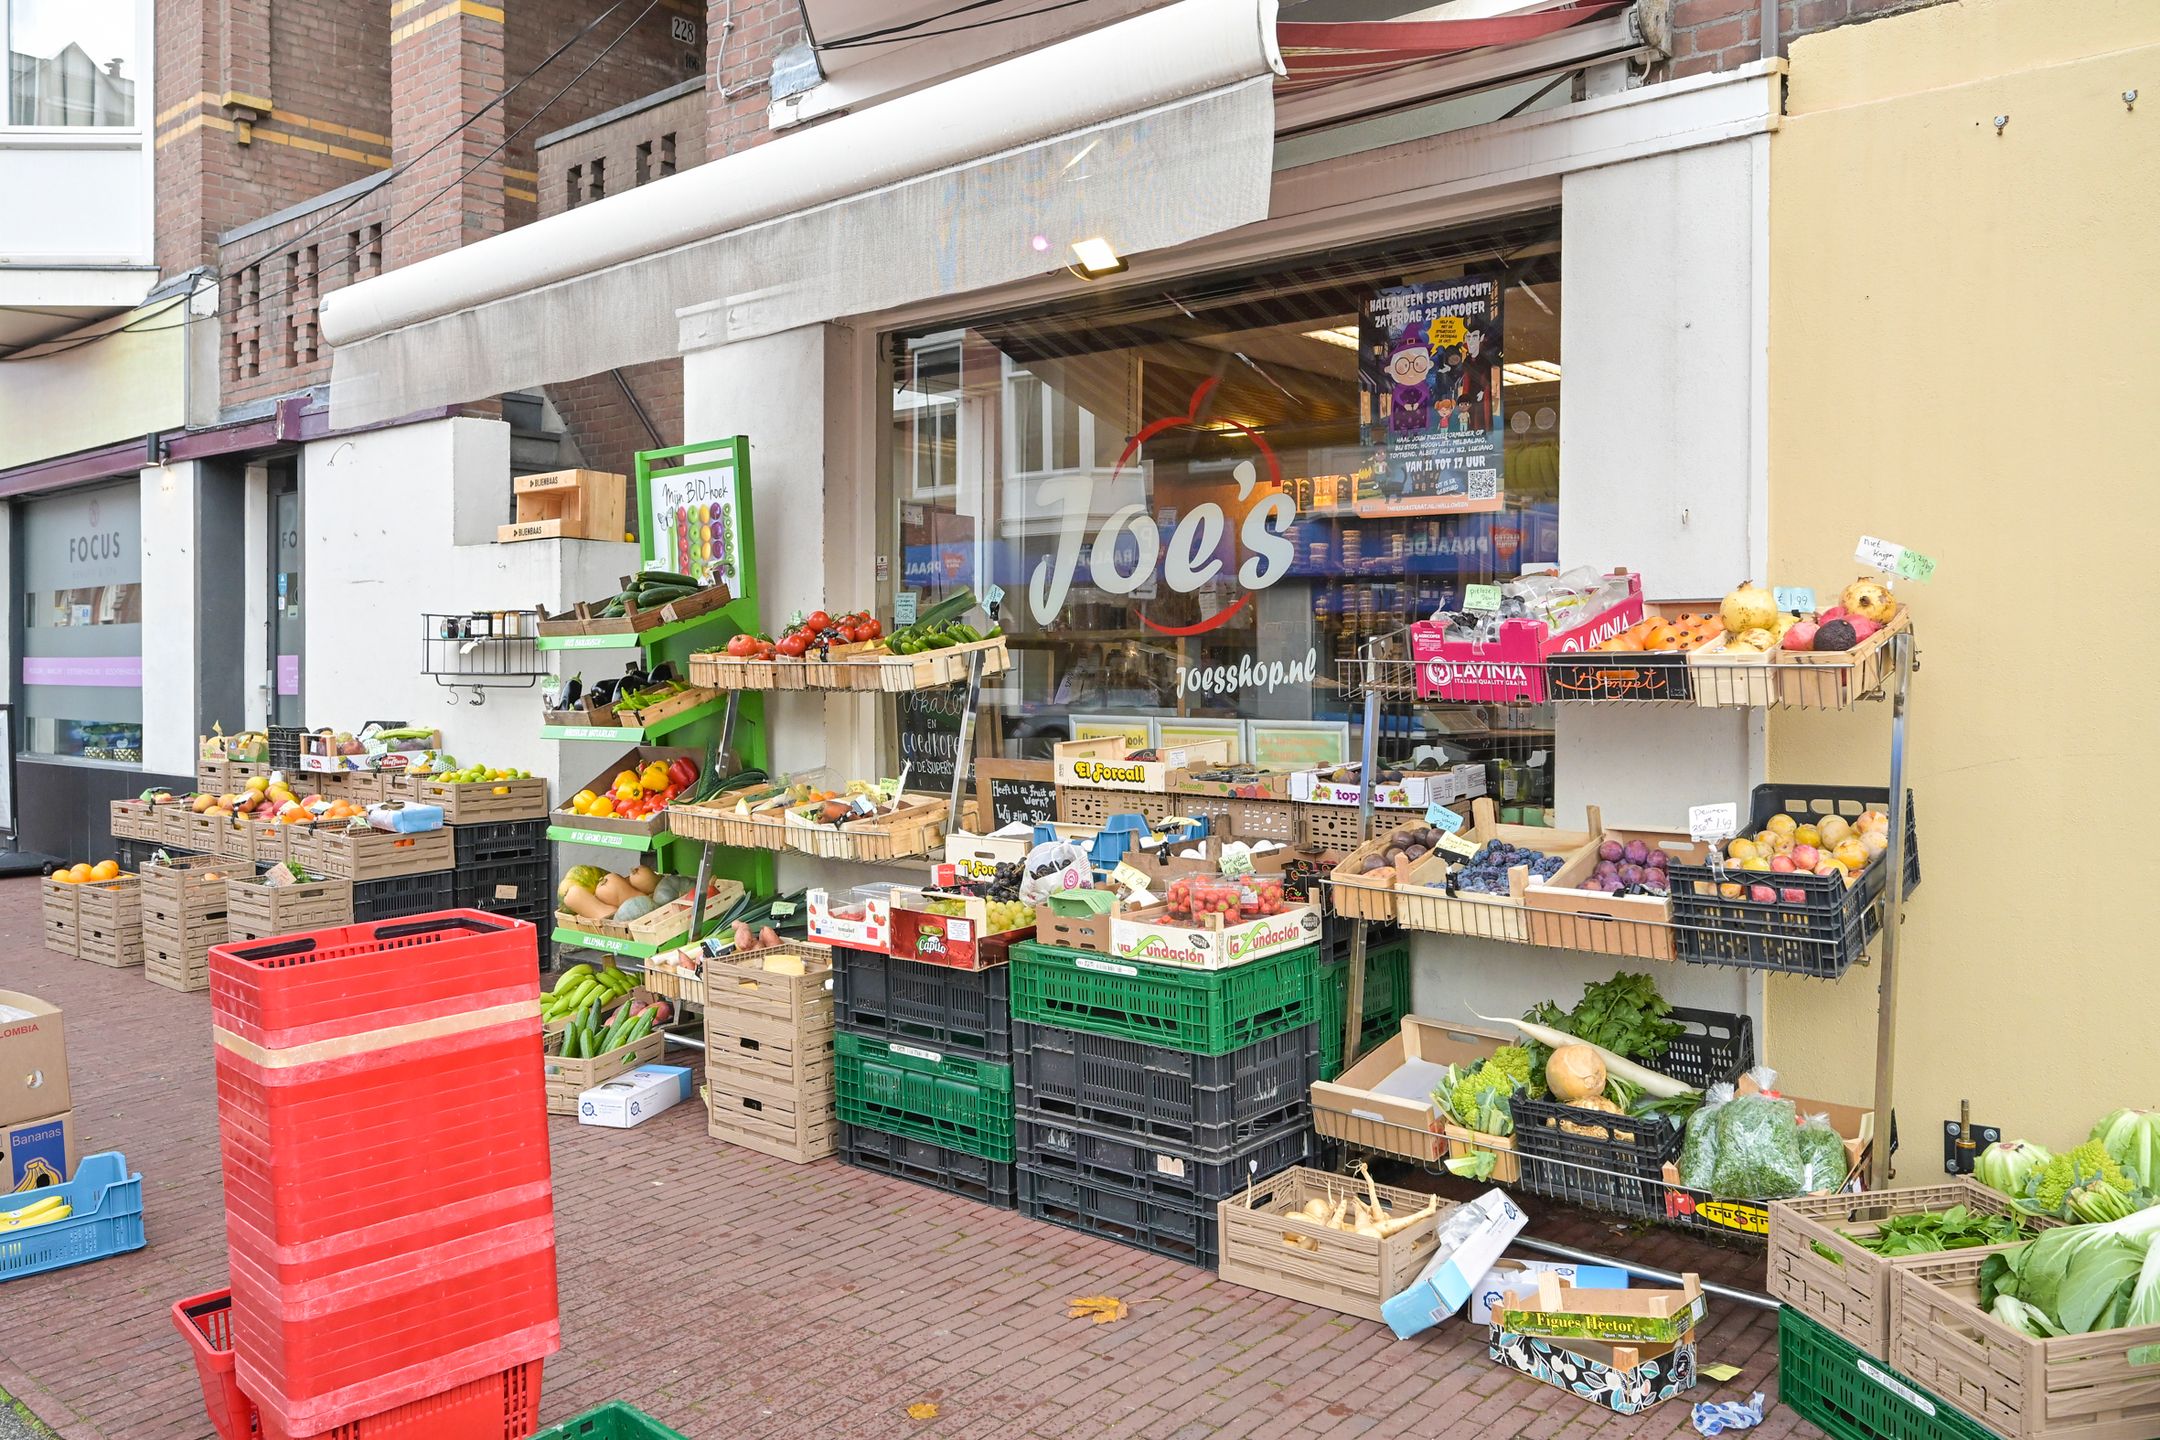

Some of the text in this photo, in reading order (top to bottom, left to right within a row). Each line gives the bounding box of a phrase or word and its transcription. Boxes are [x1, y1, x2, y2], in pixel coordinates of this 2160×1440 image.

[674, 18, 694, 43] 228
[1369, 281, 1492, 313] HALLOWEEN SPEURTOCHT!
[1374, 300, 1485, 328] ZATERDAG 25 OKTOBER
[1405, 456, 1486, 473] VAN 11 TOT 17 UUR
[534, 476, 558, 486] BIJENBAAS
[518, 526, 542, 537] BIJENBAAS
[70, 531, 120, 563] FOCUS
[1029, 460, 1297, 626] Joe's
[1453, 660, 1527, 680] LAVINIA
[927, 719, 937, 729] EN
[1075, 761, 1145, 783] El Forcall
[992, 780, 1011, 797] Heeft
[996, 804, 1011, 823] Wij
[1229, 939, 1240, 956] la
[12, 1129, 62, 1147] Bananas
[1537, 1312, 1634, 1333] Figues Hèctor
